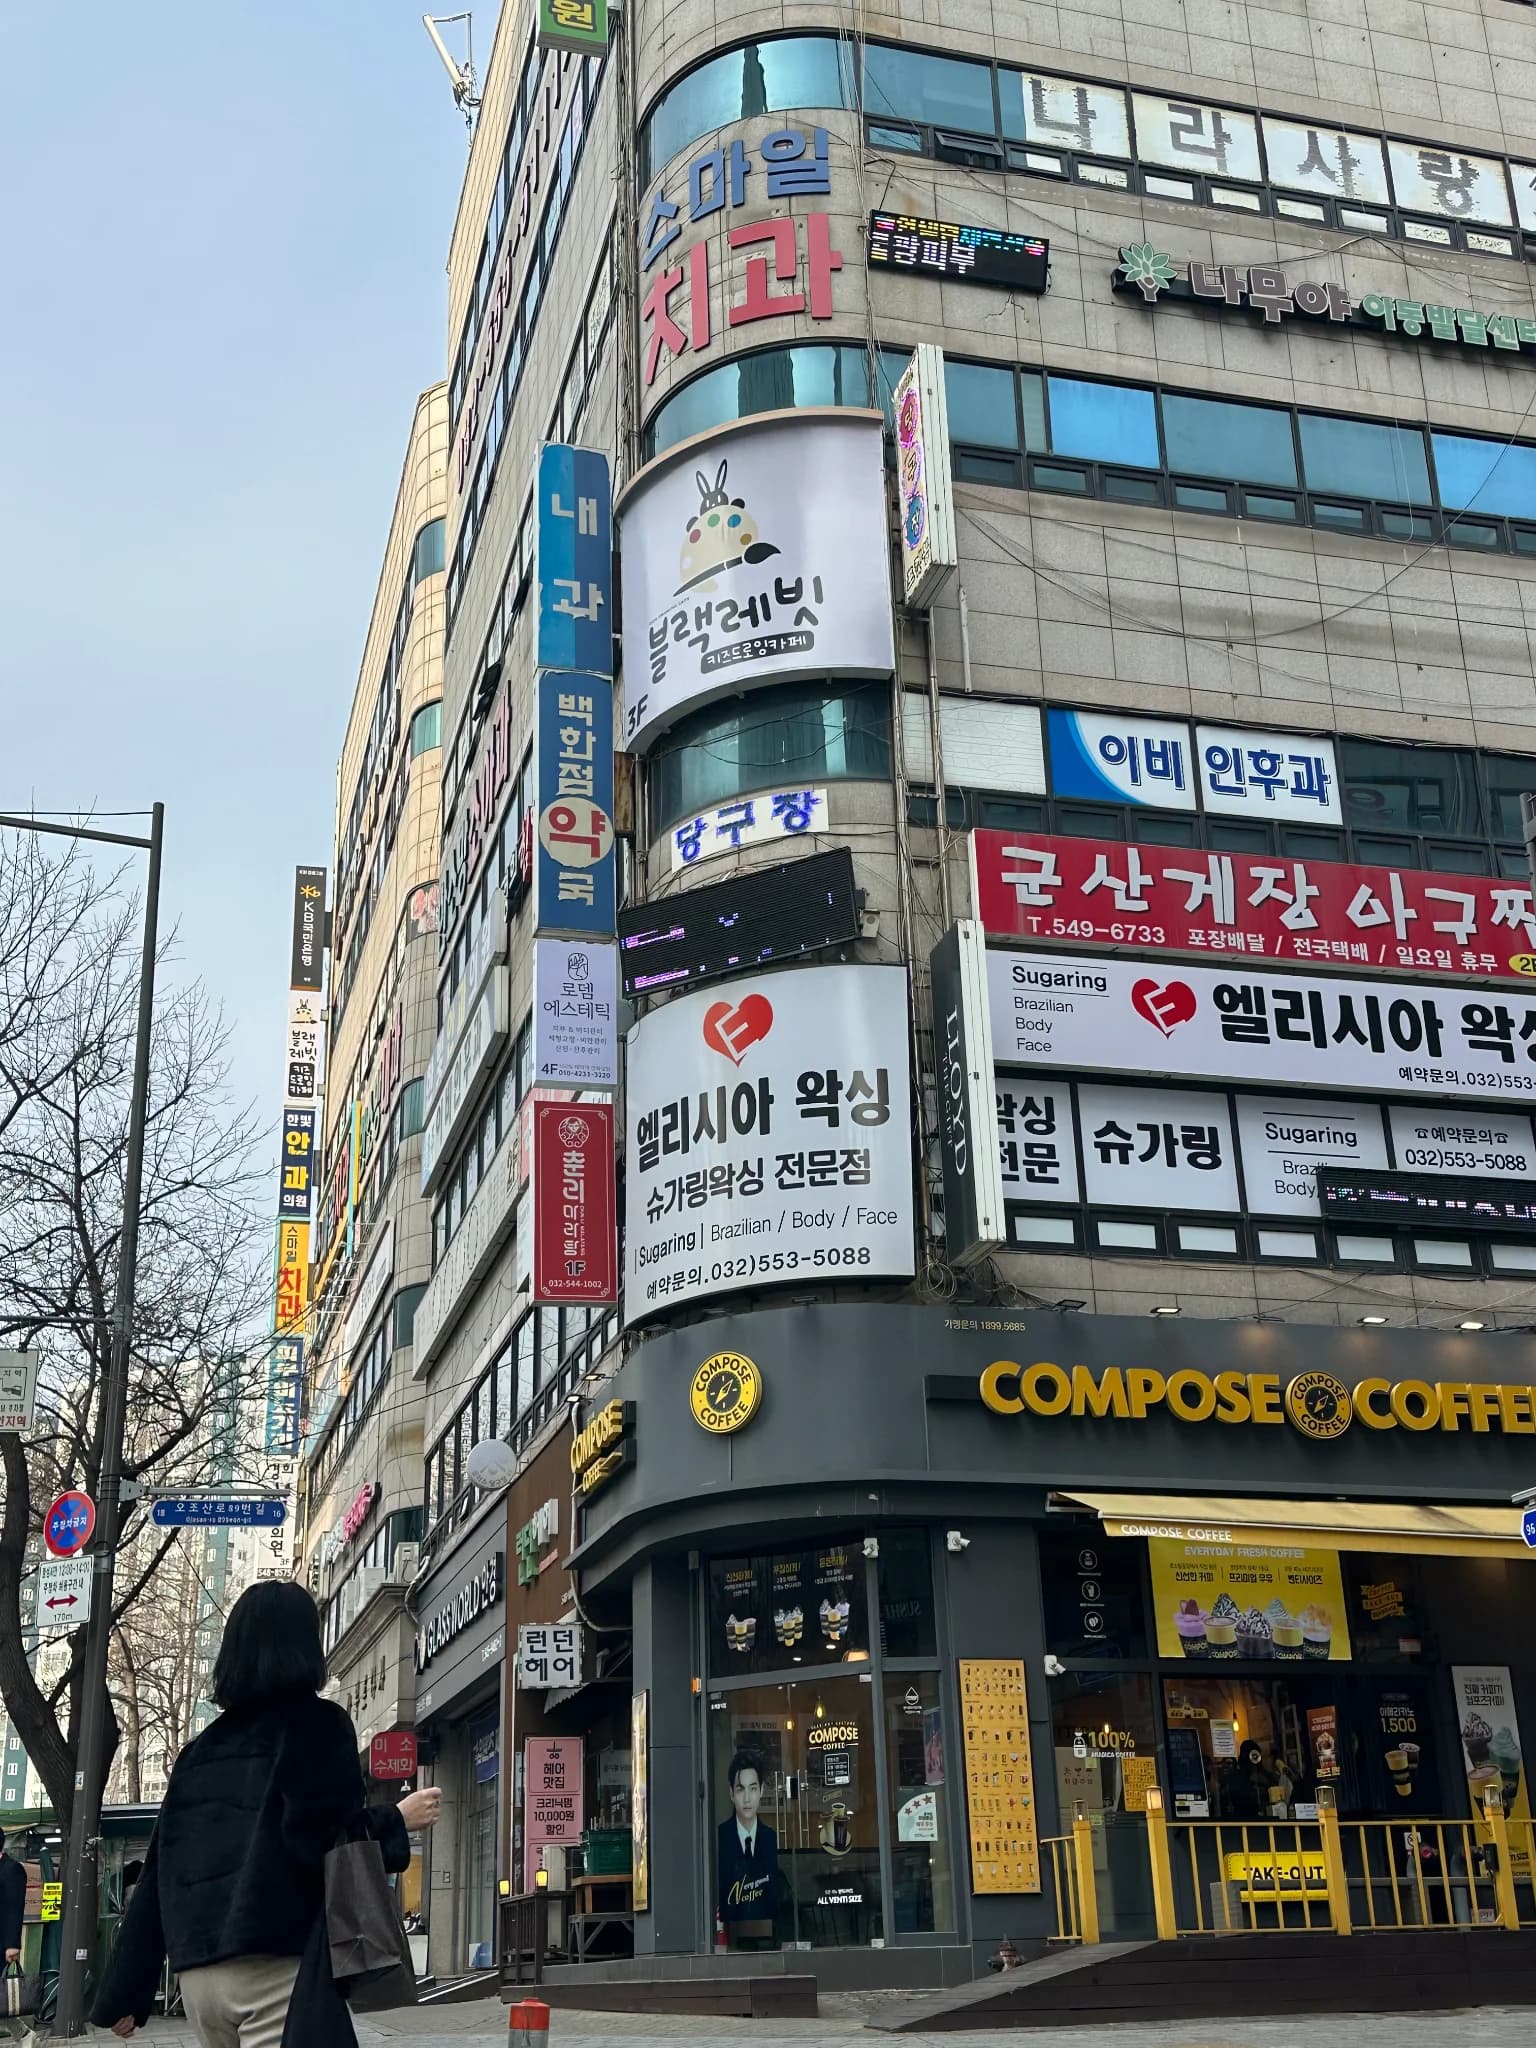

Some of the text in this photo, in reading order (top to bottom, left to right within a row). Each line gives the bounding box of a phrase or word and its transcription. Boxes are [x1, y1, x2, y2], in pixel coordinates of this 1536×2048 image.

[643, 127, 831, 272] 스마일
[643, 212, 843, 385] 치과
[1188, 261, 1353, 323] 나무야
[551, 493, 605, 621] 내과
[649, 575, 824, 685] 블랙레빗
[706, 635, 807, 666] 키즈드로잉카페
[627, 693, 649, 734] 3F
[1098, 734, 1332, 807] 이비 인후과
[674, 790, 824, 863] 당구장
[1001, 846, 1321, 931] 군산게장
[1026, 915, 1166, 945] T.549-6733
[1187, 928, 1266, 953] 포장배달
[1293, 937, 1369, 962] 전국택배
[1396, 945, 1452, 970] 일요일
[1461, 951, 1499, 972] 휴무
[560, 982, 594, 1000] 로뎀
[1011, 965, 1108, 992] Sugaring
[543, 1000, 610, 1021] 에스테틱
[1013, 996, 1074, 1013] Brazilian
[1015, 1017, 1053, 1034] Body
[1213, 983, 1444, 1058] 엘리시아
[292, 1029, 316, 1047] 블랙
[1016, 1037, 1053, 1053] Face
[289, 1047, 317, 1062] 레빗
[541, 1063, 558, 1075] 4F
[945, 1005, 968, 1177] LLOYD
[286, 1113, 312, 1128] 한빛
[637, 1076, 774, 1174] 엘리시아
[795, 1068, 891, 1128] 왁싱
[1093, 1120, 1223, 1171] 슈가링
[1265, 1122, 1358, 1147] Sugaring
[1431, 1127, 1493, 1146] 예약문의
[285, 1130, 311, 1191] 안과
[1405, 1149, 1528, 1171] 032)553-5088
[646, 1148, 871, 1224] 슈가링왁싱 전문점
[1274, 1180, 1316, 1198] Body
[283, 1193, 308, 1208] 의원
[563, 1150, 585, 1256] 춘리 마라탕
[285, 1225, 298, 1263] 스마일
[638, 1228, 696, 1268] Sugaring
[711, 1217, 771, 1242] Brazilian
[792, 1209, 835, 1231] Body
[857, 1207, 898, 1226] Face
[564, 1259, 586, 1277] 1F
[278, 1267, 301, 1319] 치과
[695, 1356, 752, 1392] COMPOSE
[1293, 1372, 1345, 1400] COMPOSE
[980, 1360, 1536, 1434] COMPOSE COFFE
[699, 1402, 748, 1428] COFFEE
[1301, 1412, 1347, 1435] COFFEE
[571, 1398, 623, 1474] COMPOSE
[52, 1516, 88, 1532] 주정차금지
[272, 1509, 282, 1519] 16
[1120, 1523, 1233, 1542] COMPOSE COFFEE
[1184, 1544, 1305, 1560] EVERYDAY FRESH COFFEE
[526, 1629, 574, 1654] 런던
[525, 1656, 574, 1682] 헤어
[374, 1735, 413, 1754] 미소
[808, 1726, 859, 1744] COMPOSE
[1088, 1731, 1135, 1748] 100%
[374, 1757, 414, 1773] 수제화
[543, 1762, 565, 1775] 헤어
[543, 1776, 565, 1789] 맛집
[533, 1810, 575, 1823] 10,000원
[545, 1823, 565, 1836] 할인
[1243, 1864, 1324, 1882] TAKE-OUT
[817, 1895, 828, 1905] ALL
